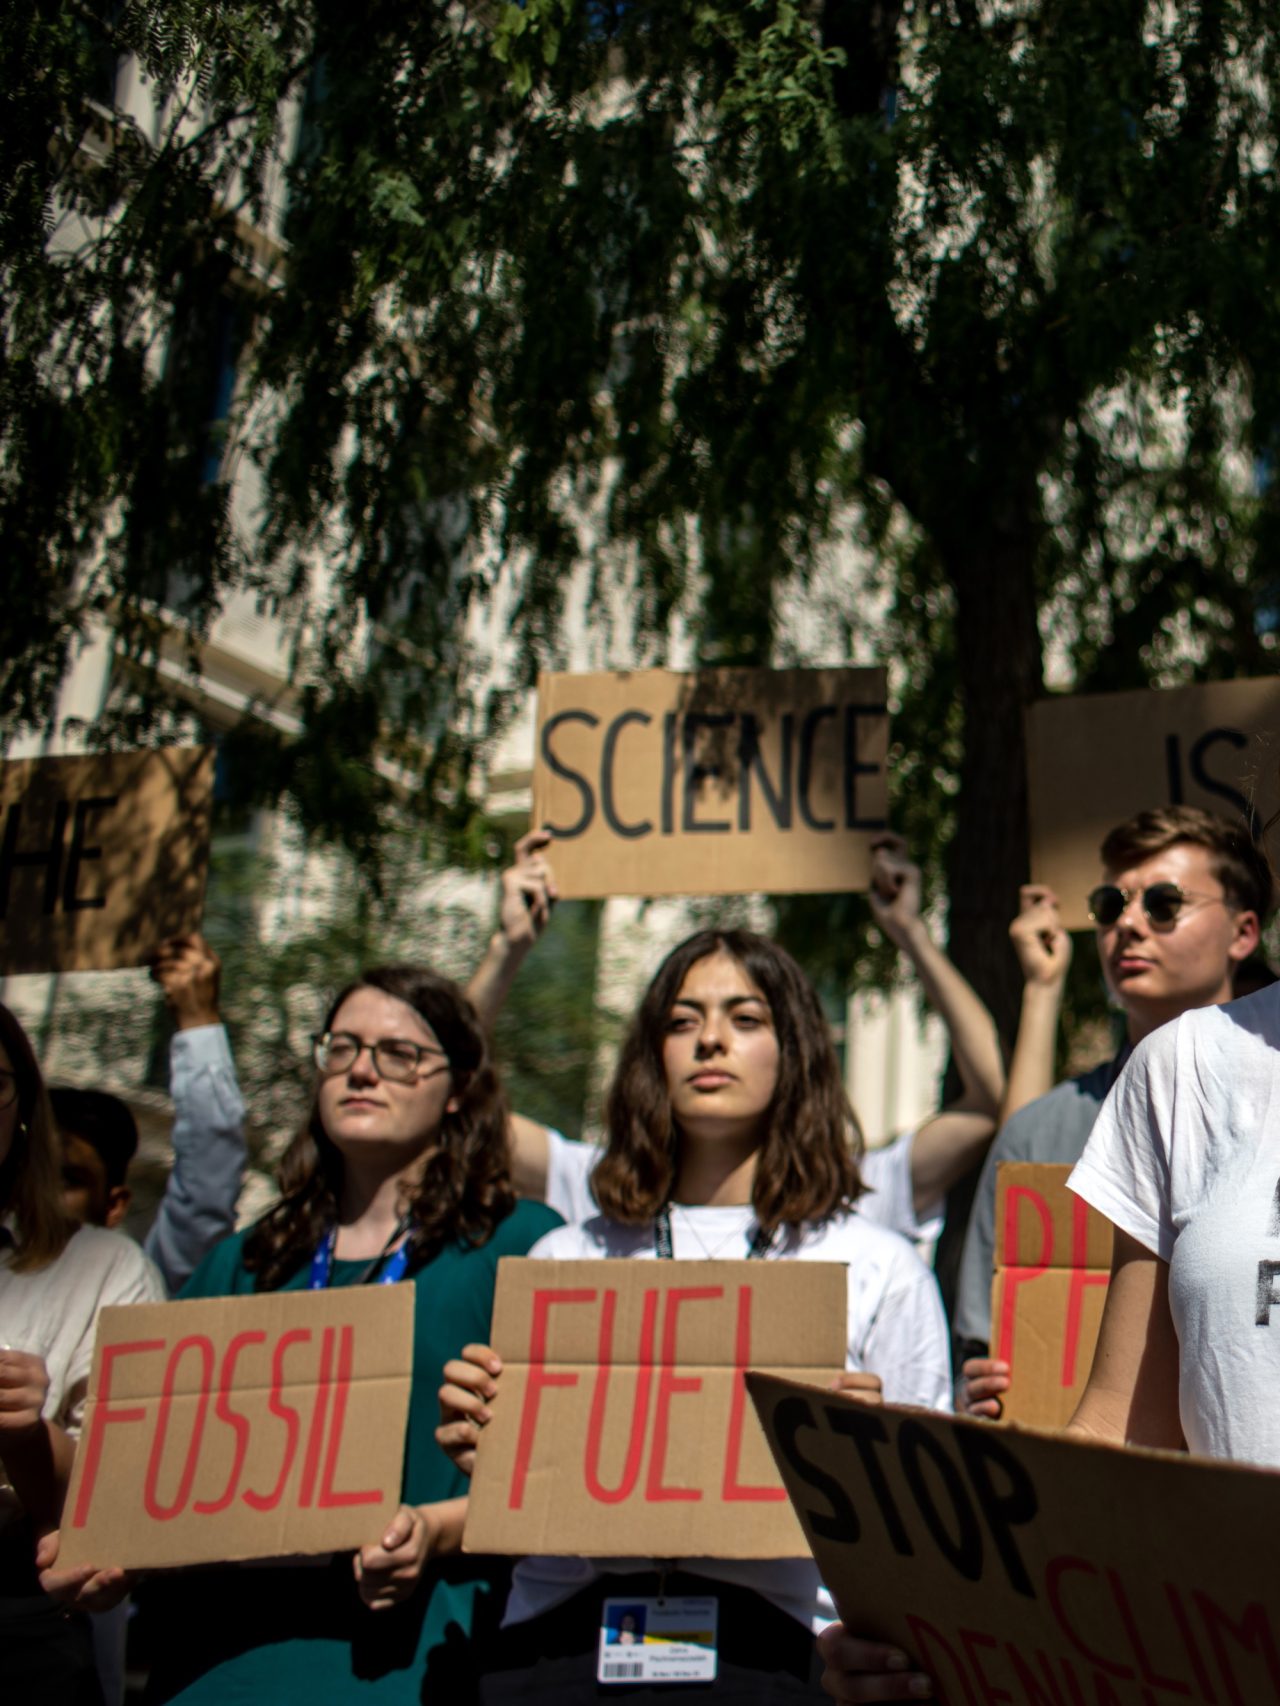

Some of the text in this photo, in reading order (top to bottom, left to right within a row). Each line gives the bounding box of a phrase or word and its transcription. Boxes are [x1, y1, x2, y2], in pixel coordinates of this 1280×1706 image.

[541, 707, 886, 839] SCIENCE
[1166, 728, 1261, 840] IS
[72, 1324, 384, 1529] FOSSIL
[508, 1285, 790, 1510] FUEL
[774, 1397, 1037, 1600] STOP
